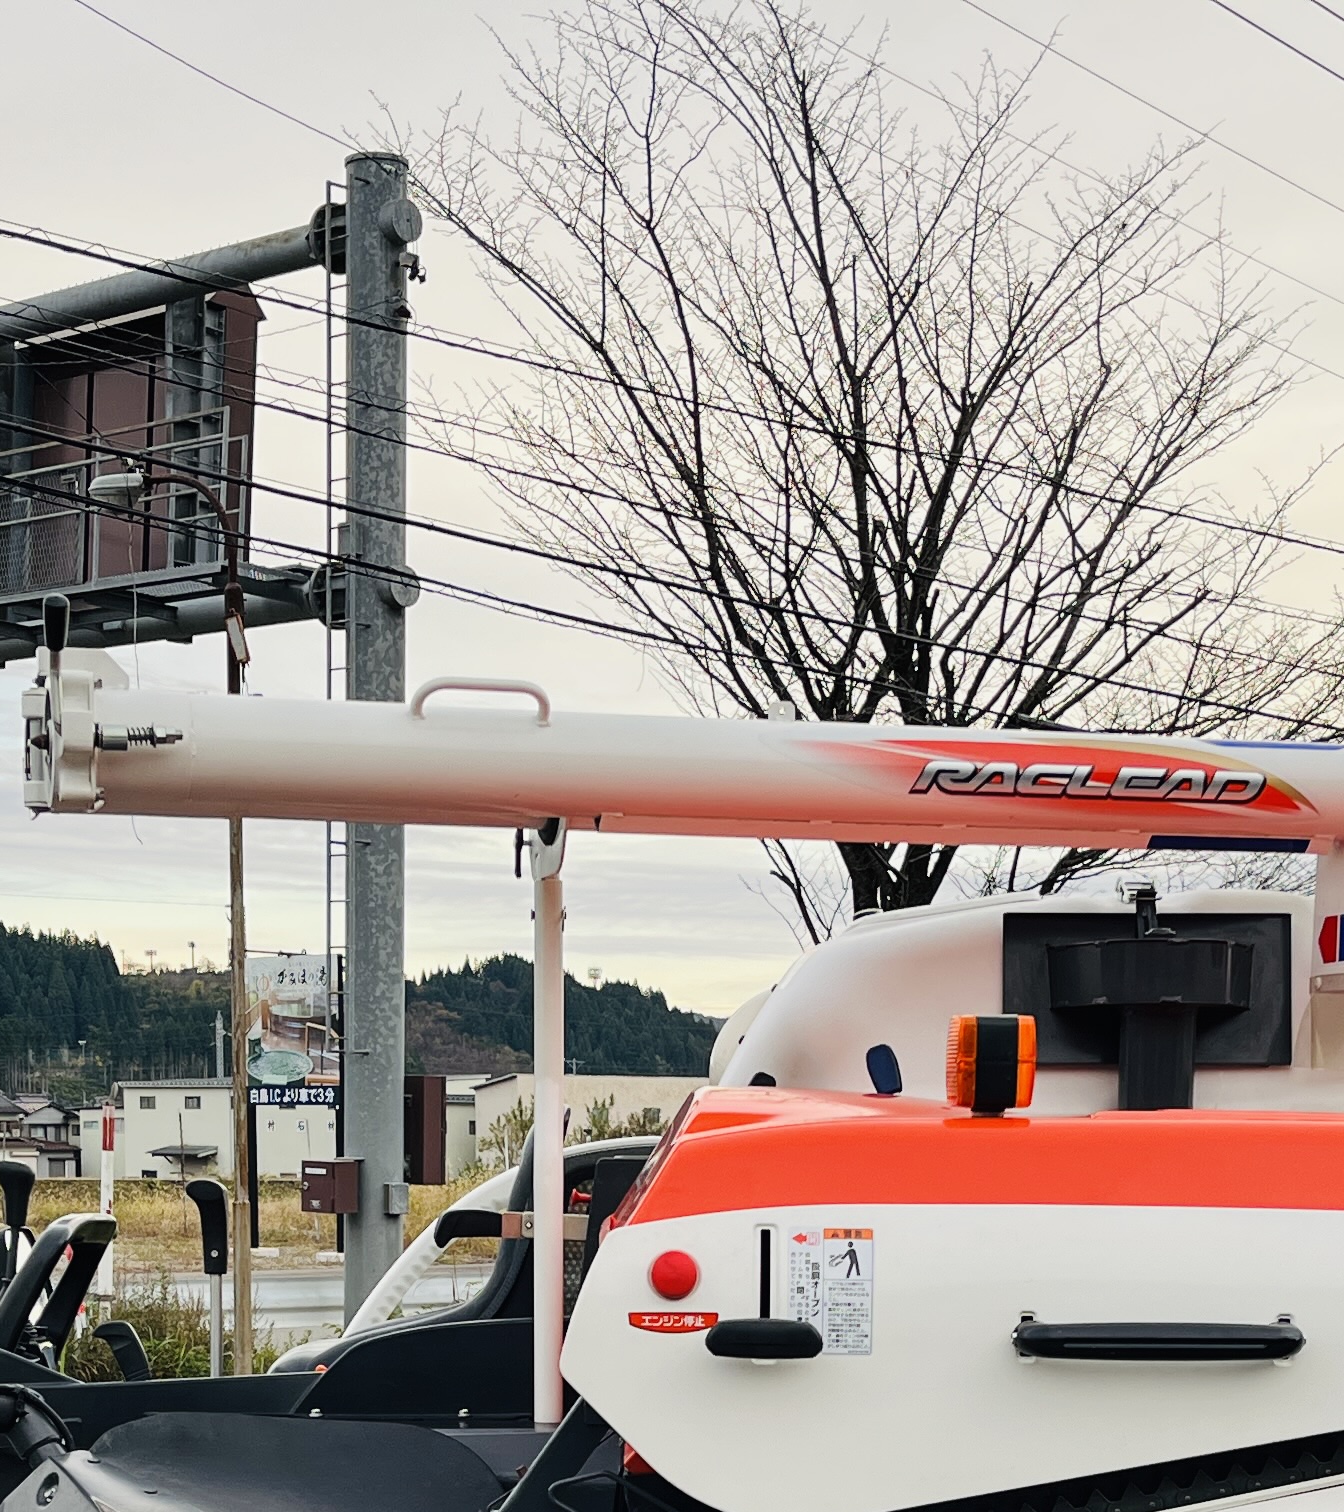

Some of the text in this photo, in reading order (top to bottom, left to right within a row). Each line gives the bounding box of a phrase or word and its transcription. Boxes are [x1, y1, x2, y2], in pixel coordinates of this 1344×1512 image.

[908, 760, 1267, 804] RACLEAD
[640, 1315, 706, 1327] エンジン停止
